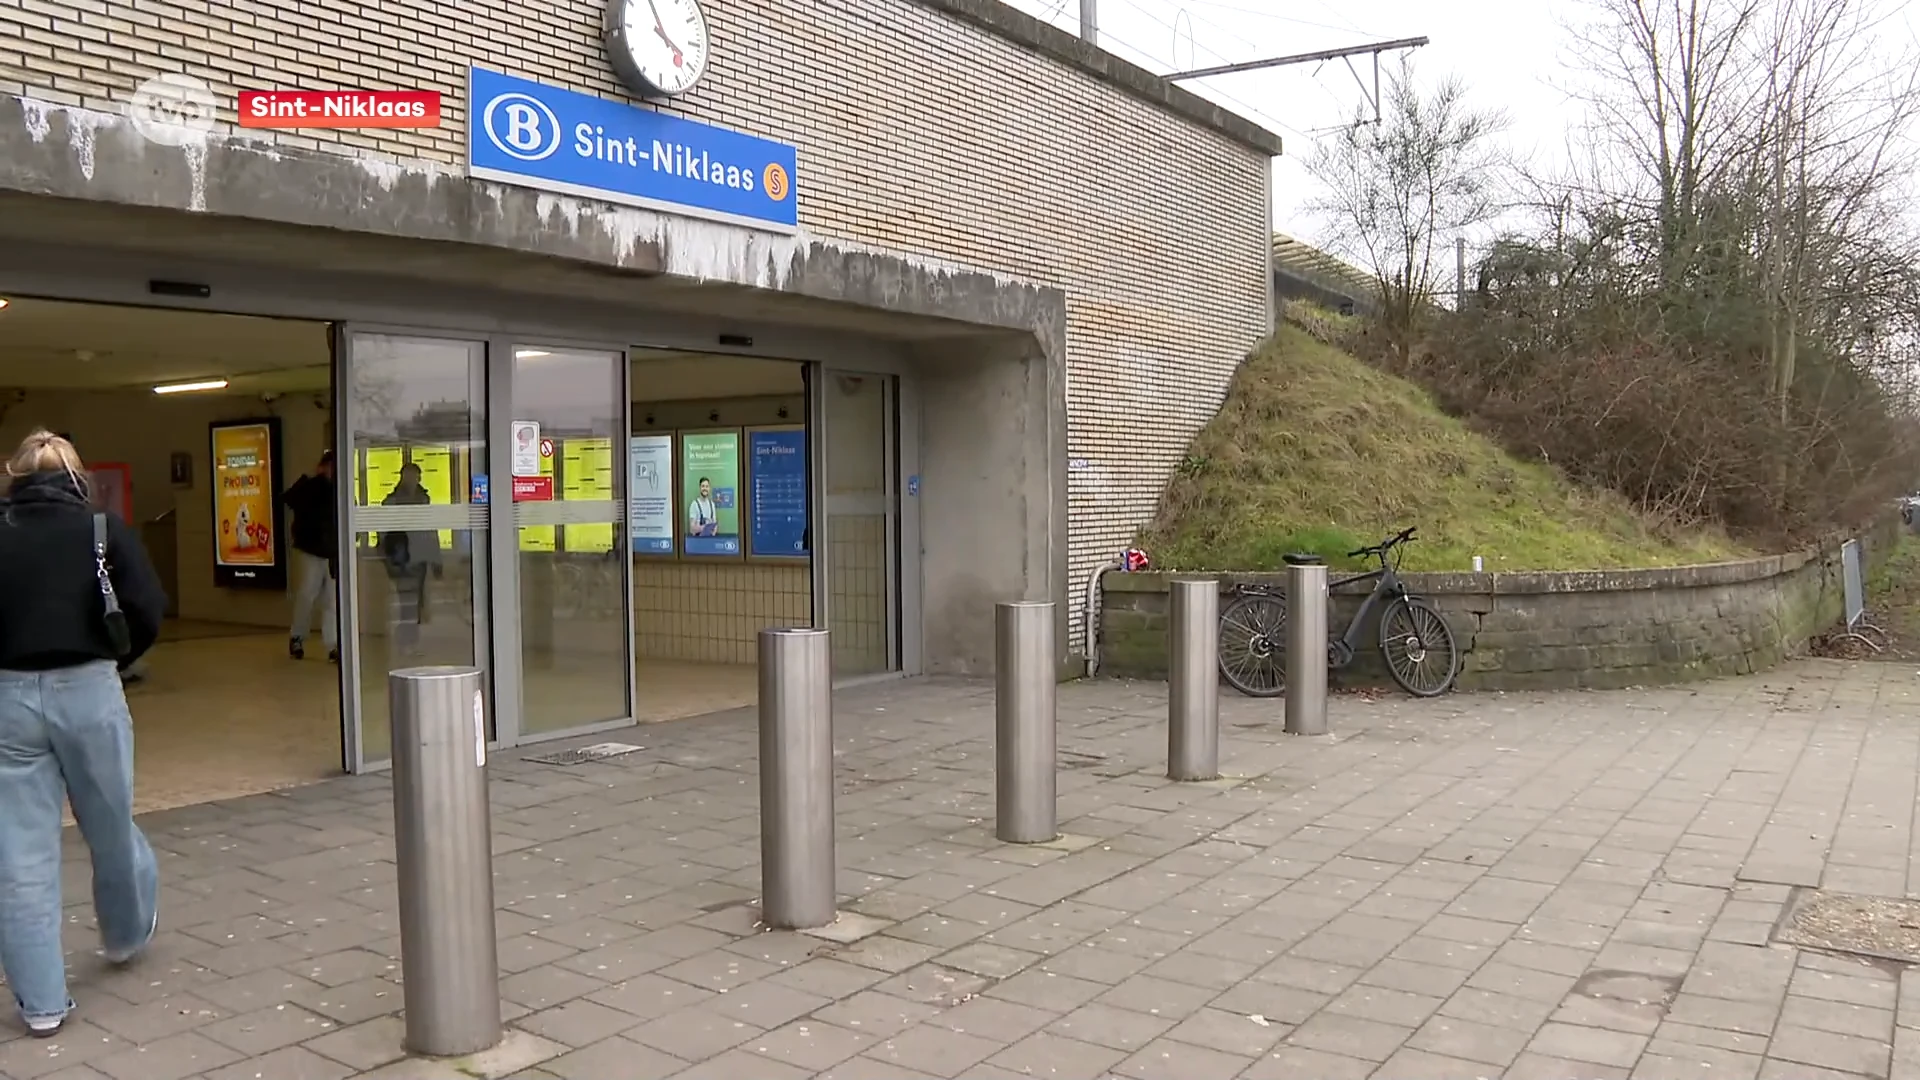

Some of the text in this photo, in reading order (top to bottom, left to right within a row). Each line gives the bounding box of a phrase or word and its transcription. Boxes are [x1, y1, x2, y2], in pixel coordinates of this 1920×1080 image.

[504, 103, 542, 150] B
[574, 122, 755, 192] Sint-Niklaas
[770, 167, 783, 196] S
